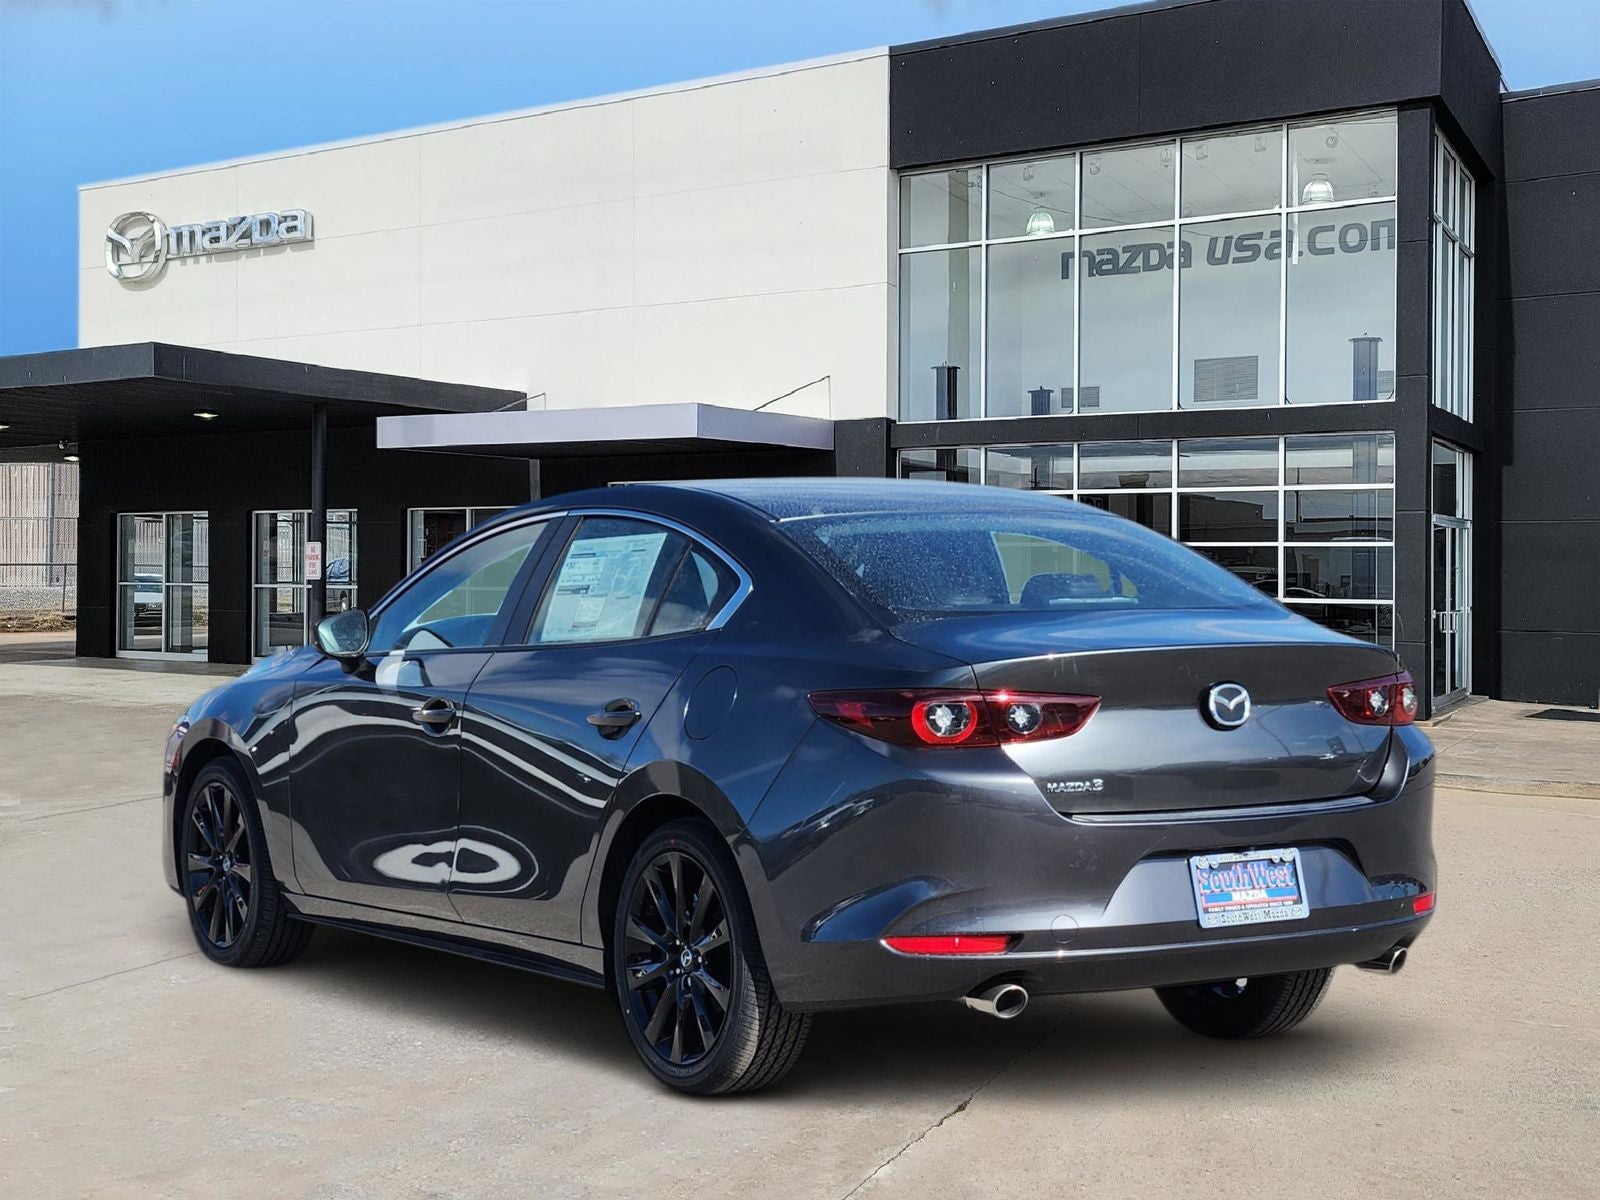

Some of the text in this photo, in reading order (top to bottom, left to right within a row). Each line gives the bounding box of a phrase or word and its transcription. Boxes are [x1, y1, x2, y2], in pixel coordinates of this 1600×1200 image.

[166, 209, 313, 256] mazda
[1061, 240, 1193, 280] mazda
[1046, 778, 1104, 793] MAZDA3
[1197, 861, 1295, 893] SouthWest
[1231, 888, 1269, 901] MAZDA
[1263, 909, 1289, 920] Mazda
